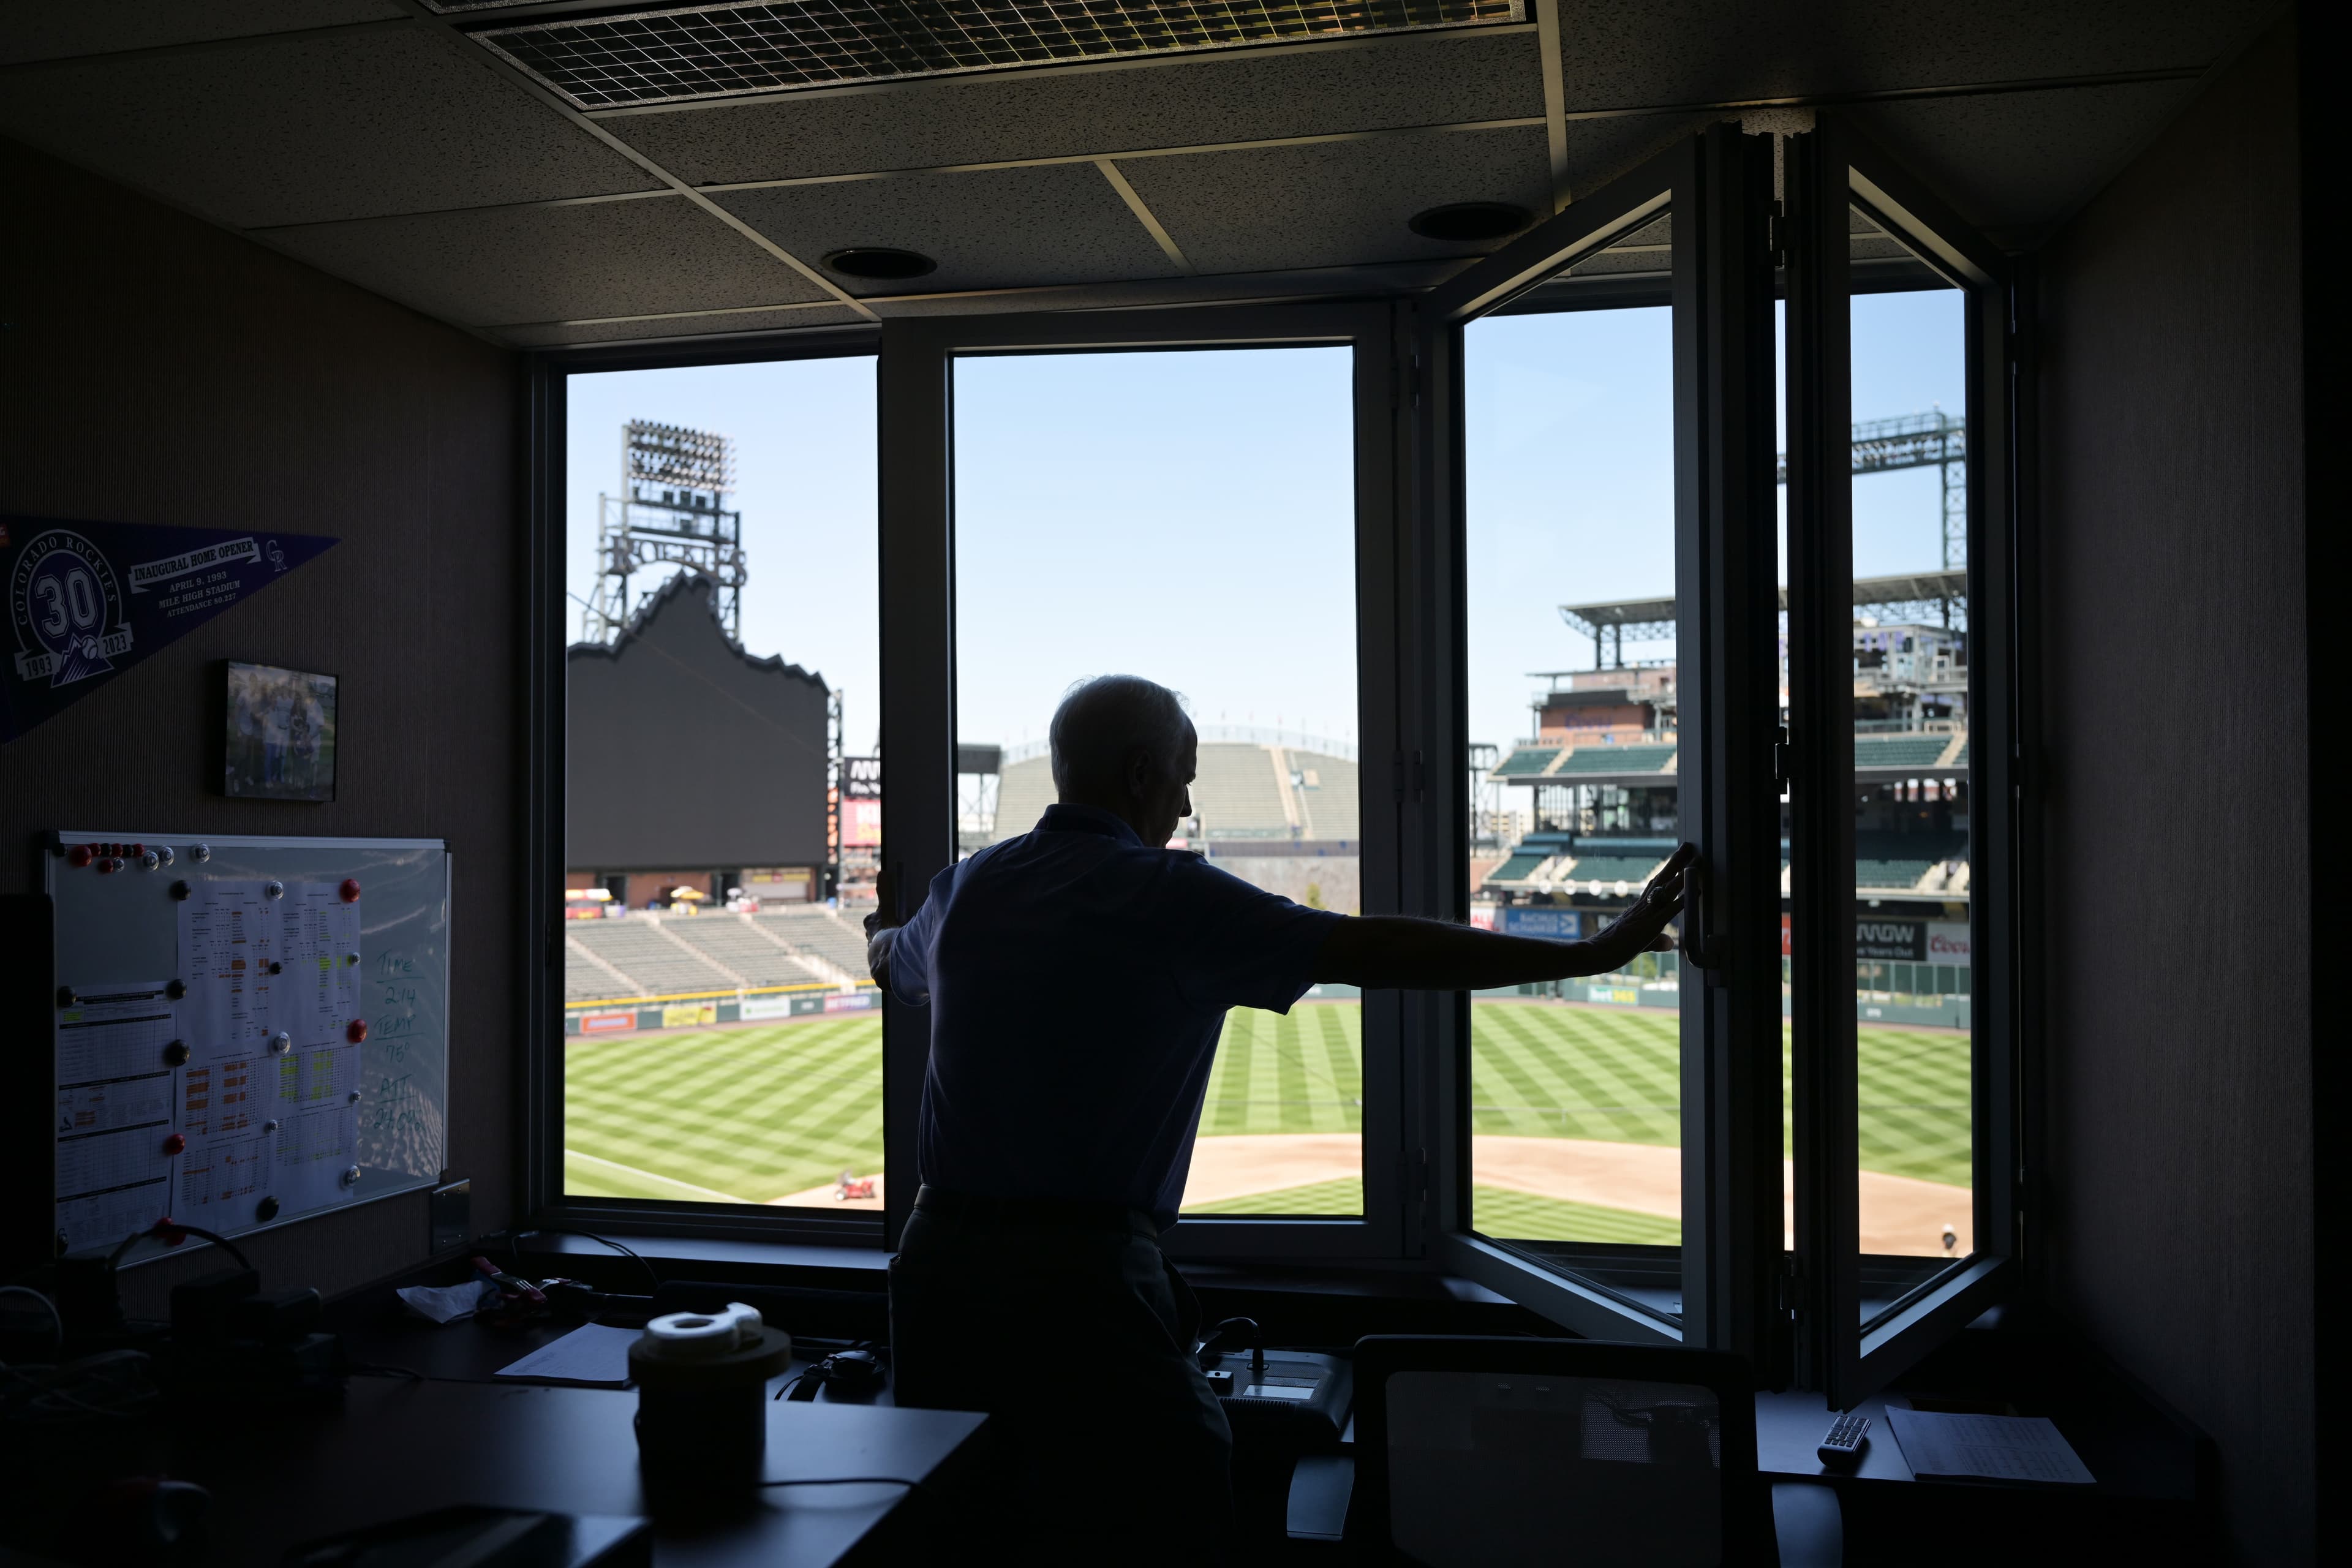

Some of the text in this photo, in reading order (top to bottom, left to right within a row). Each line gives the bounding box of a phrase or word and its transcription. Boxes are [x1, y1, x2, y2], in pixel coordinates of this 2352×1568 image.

[134, 540, 254, 581] INAUGURAL HOME OPENER
[15, 536, 116, 626] COLORADO ROCKIES
[169, 579, 195, 594] APRIL
[206, 571, 227, 583] 1993
[34, 567, 98, 639] 30
[158, 579, 241, 609] MILE HIGH STADIUM
[166, 598, 213, 618] ATTENDANCE
[102, 636, 127, 655] 2023
[26, 656, 53, 674] 1993
[377, 948, 412, 975] TIME
[385, 987, 416, 1007] 2:14
[374, 1014, 417, 1035] TEMP
[380, 1074, 412, 1097] ATT
